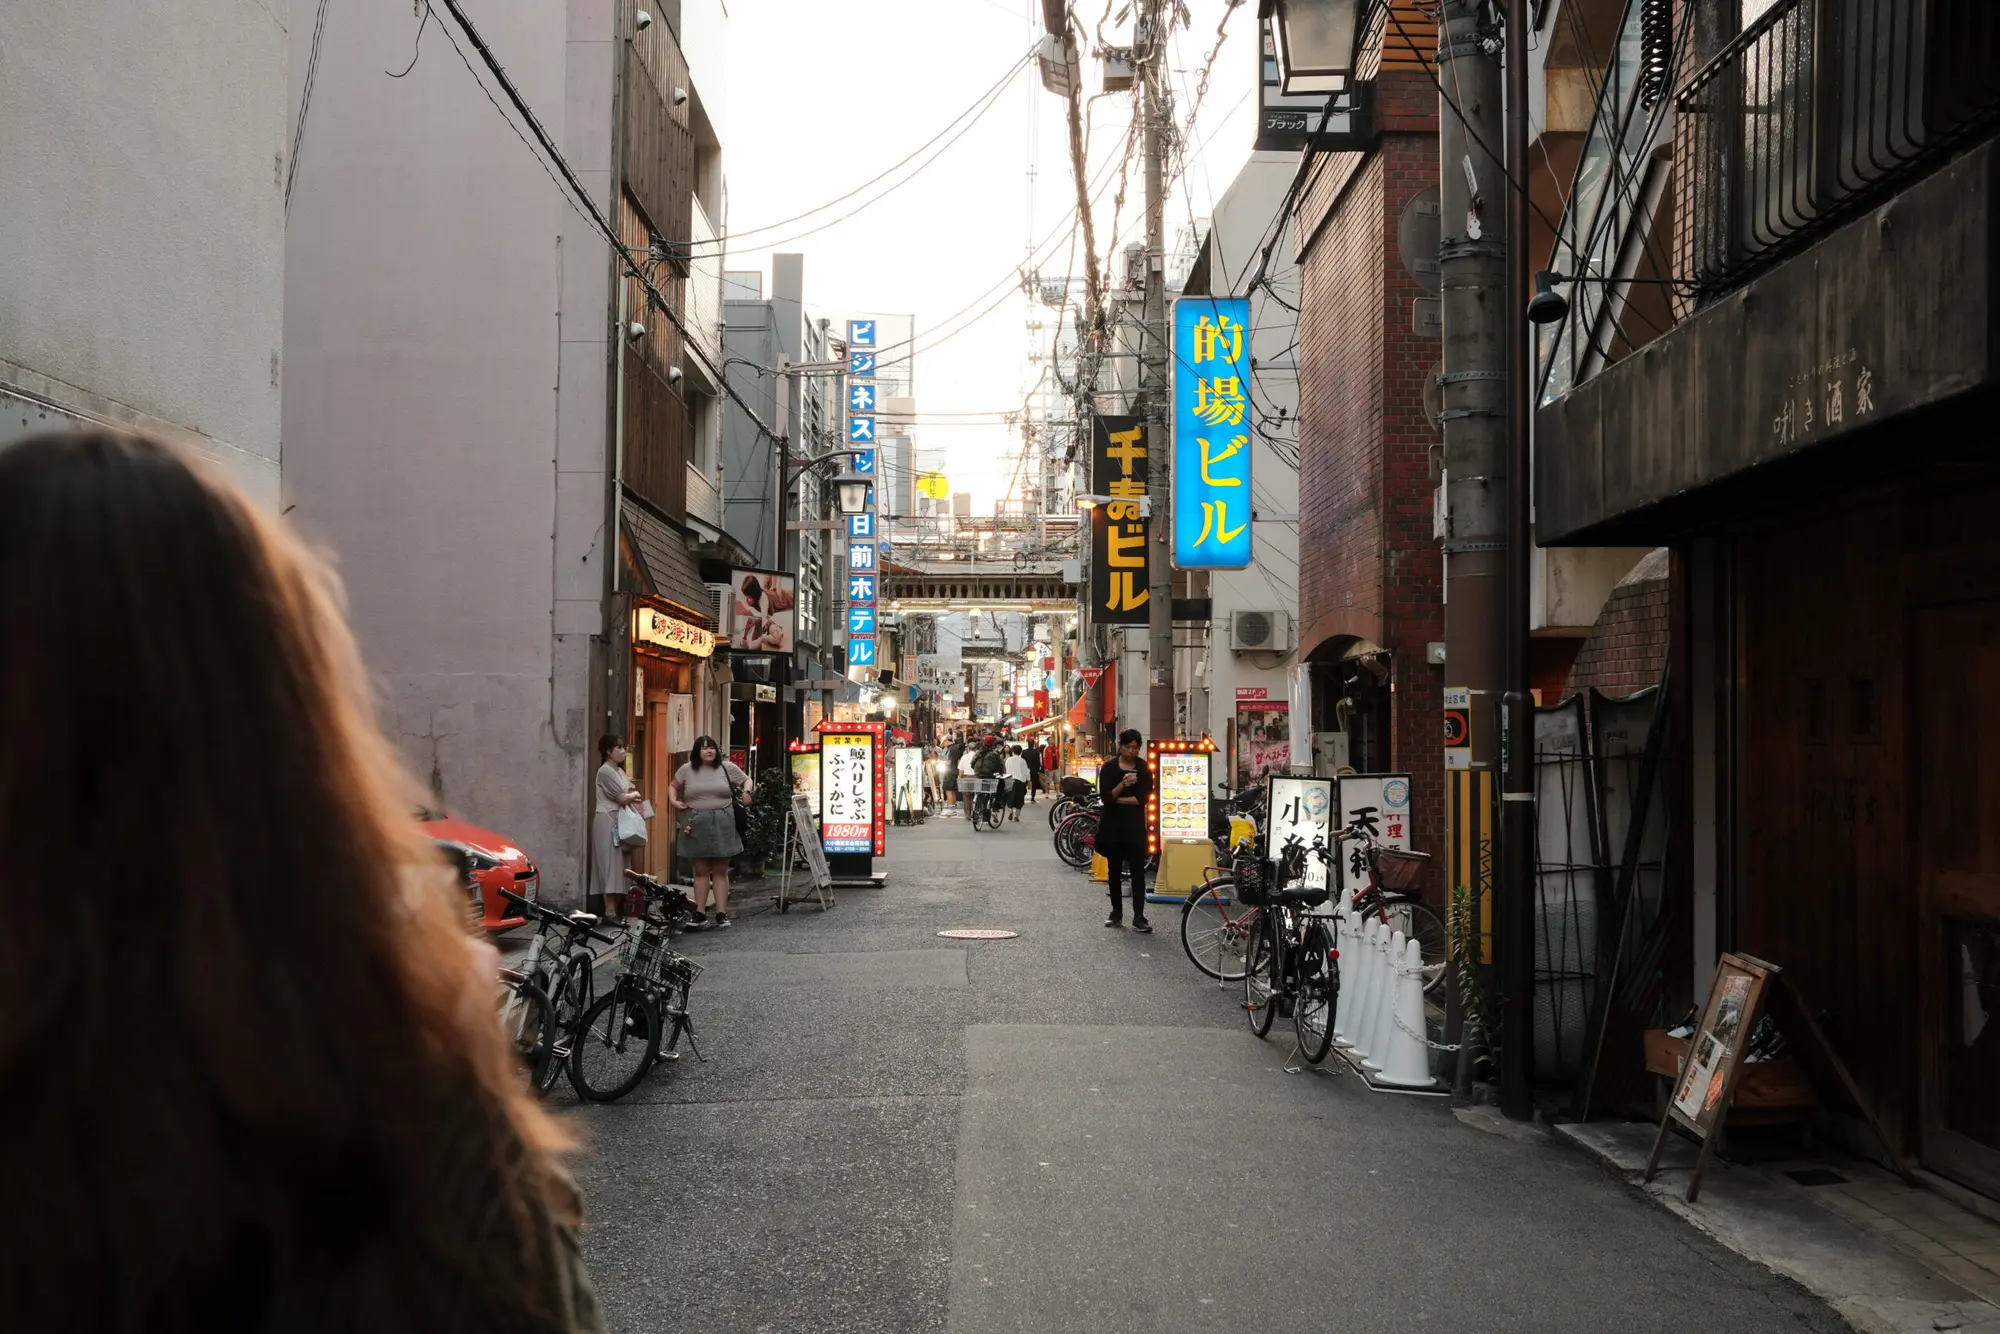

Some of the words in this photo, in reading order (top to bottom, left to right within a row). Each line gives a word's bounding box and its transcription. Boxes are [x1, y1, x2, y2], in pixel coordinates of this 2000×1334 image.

[1267, 119, 1306, 130] ブラック
[1192, 315, 1249, 548] 的場ビル
[829, 753, 845, 815] ふぐ・かに
[826, 824, 869, 837] 1980円
